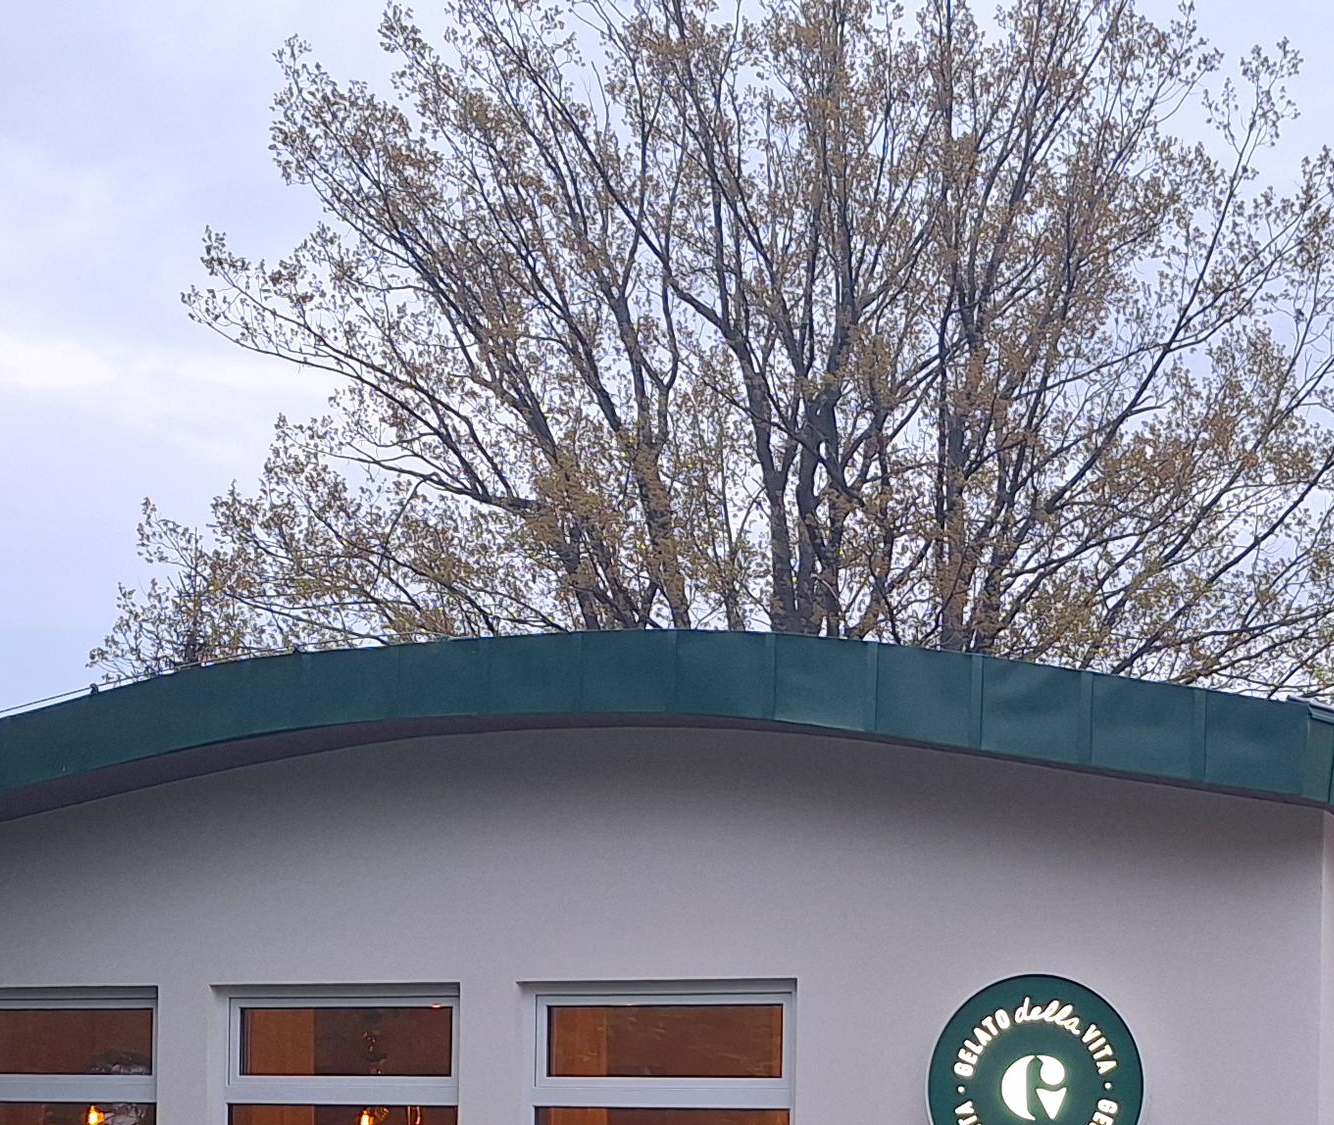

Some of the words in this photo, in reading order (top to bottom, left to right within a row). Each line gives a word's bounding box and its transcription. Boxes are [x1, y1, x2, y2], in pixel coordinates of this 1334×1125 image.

[953, 1008, 1011, 1078] GELATO
[1014, 996, 1081, 1036] della
[1081, 1023, 1118, 1075] VITA
